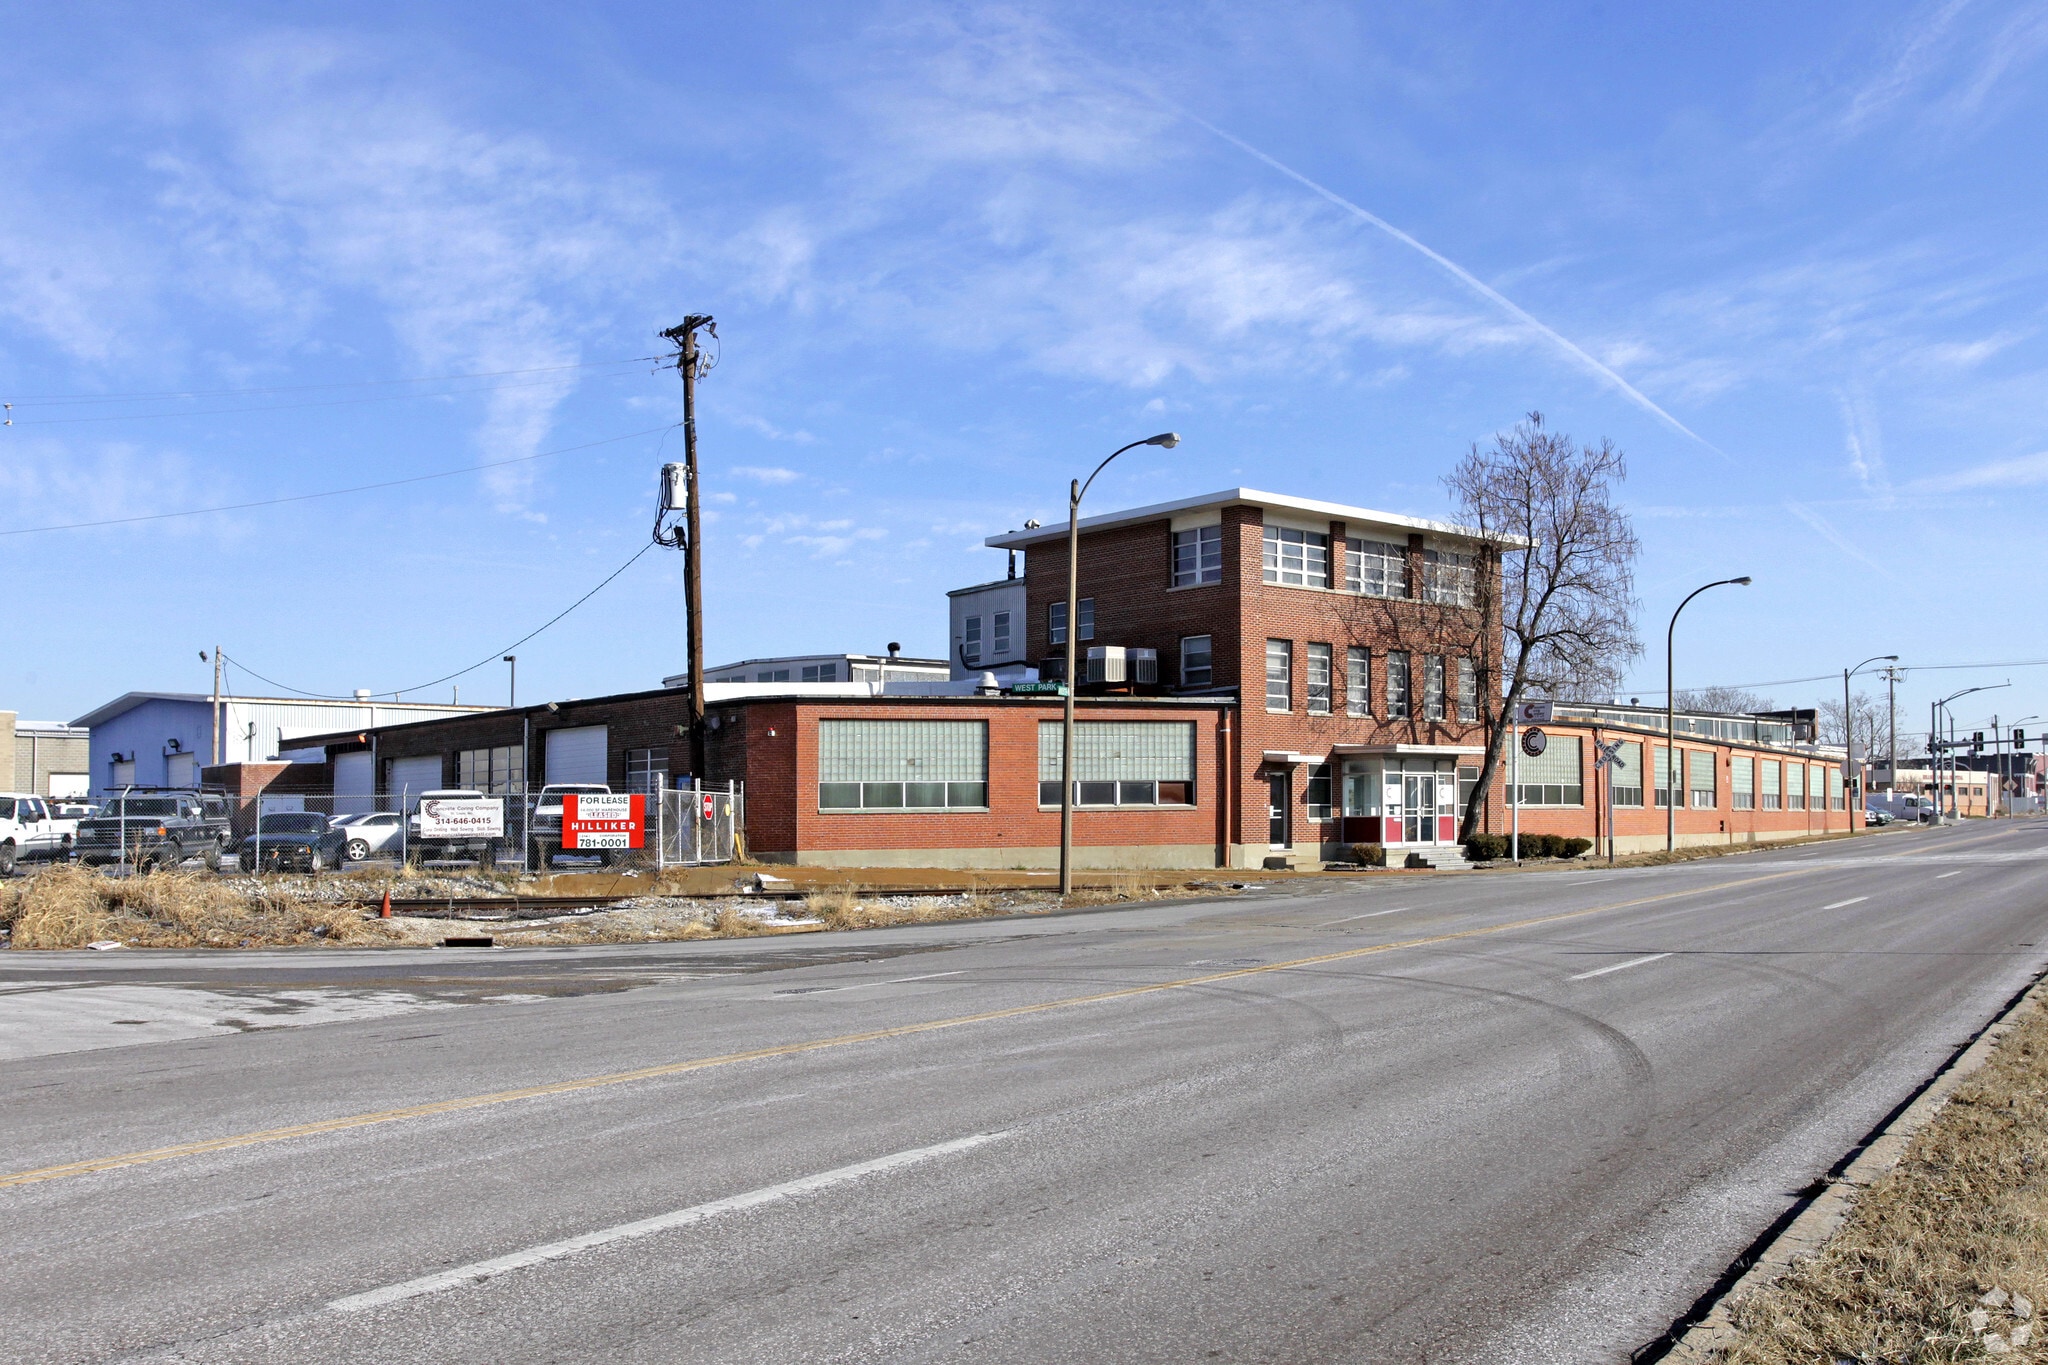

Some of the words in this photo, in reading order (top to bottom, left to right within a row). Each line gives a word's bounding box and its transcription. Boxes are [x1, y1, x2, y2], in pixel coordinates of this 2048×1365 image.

[1596, 740, 1624, 768] CROSSING
[704, 802, 712, 811] STOP
[571, 822, 636, 830] HILLIKER
[580, 839, 626, 847] 781-0001
